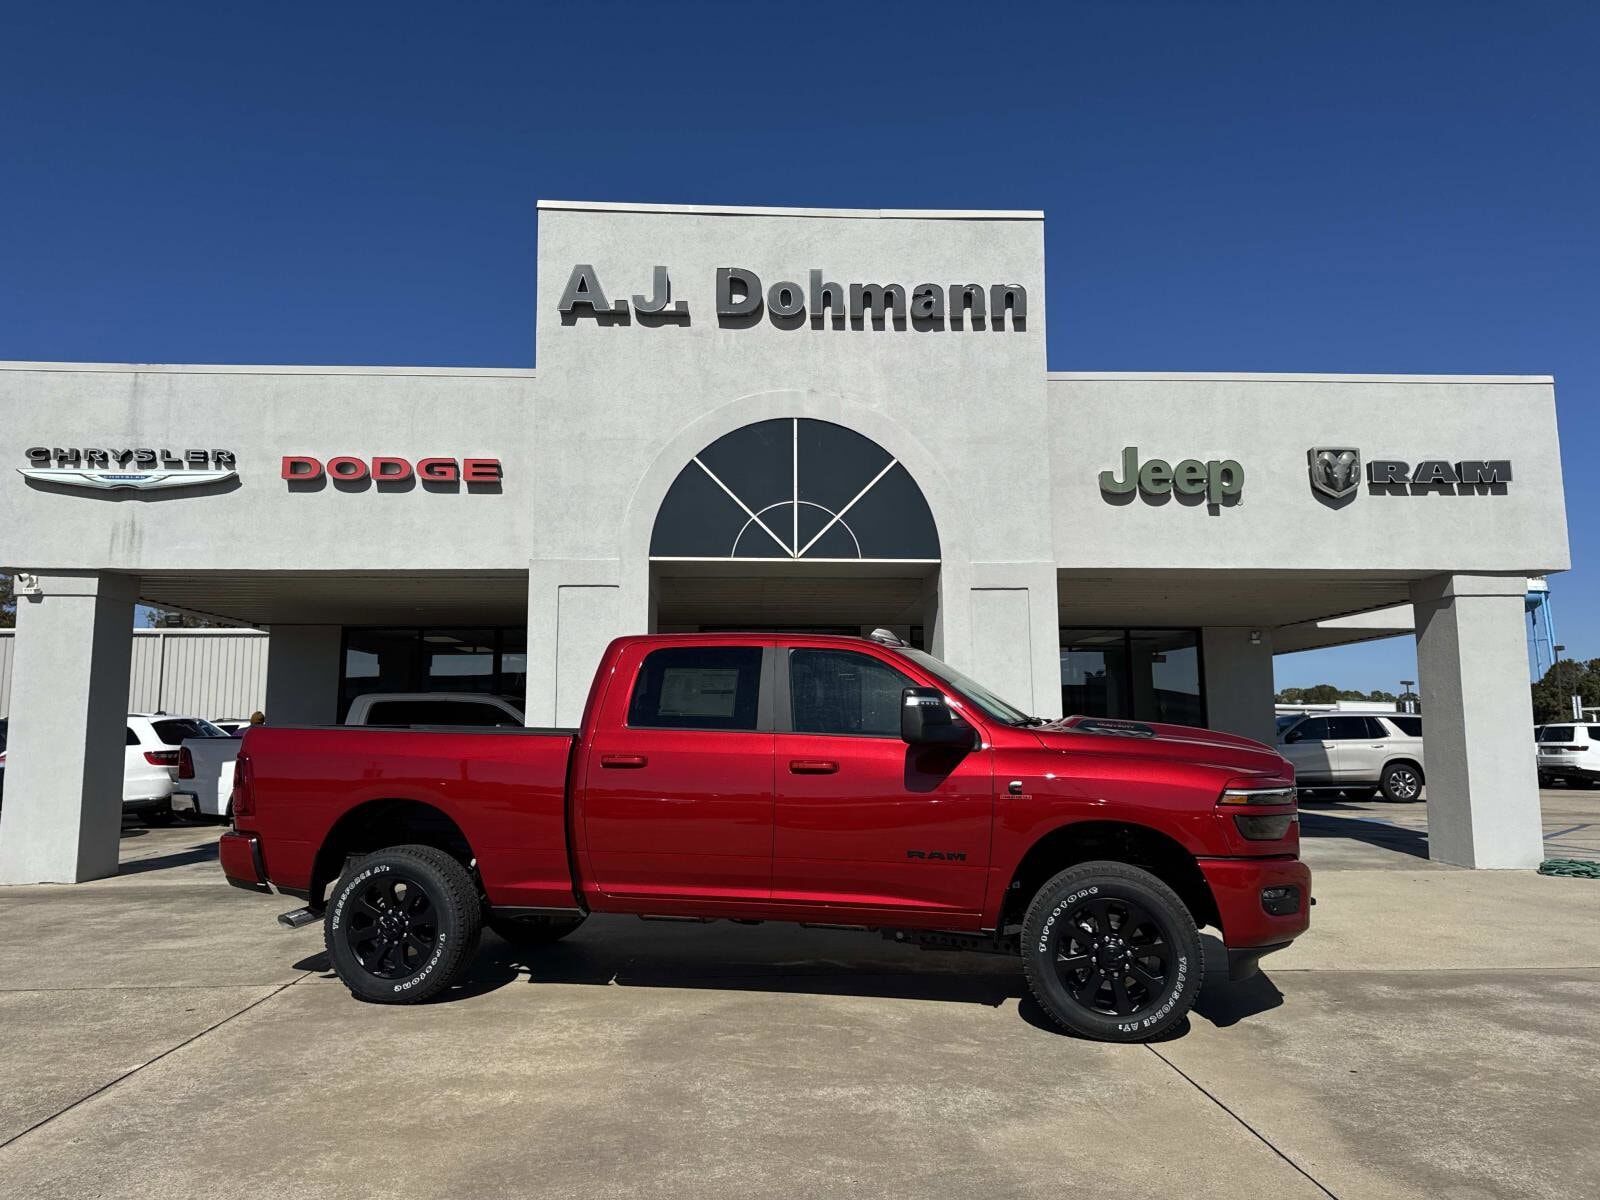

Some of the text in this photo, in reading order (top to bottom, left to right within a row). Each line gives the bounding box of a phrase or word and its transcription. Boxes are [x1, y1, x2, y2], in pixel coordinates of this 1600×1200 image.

[557, 264, 1027, 320] A.J. Dohmann
[24, 446, 234, 465] CHRYSLER
[281, 456, 502, 483] DODGE
[1099, 447, 1245, 504] Jeep
[1367, 460, 1512, 485] RAM
[906, 850, 967, 861] RAM
